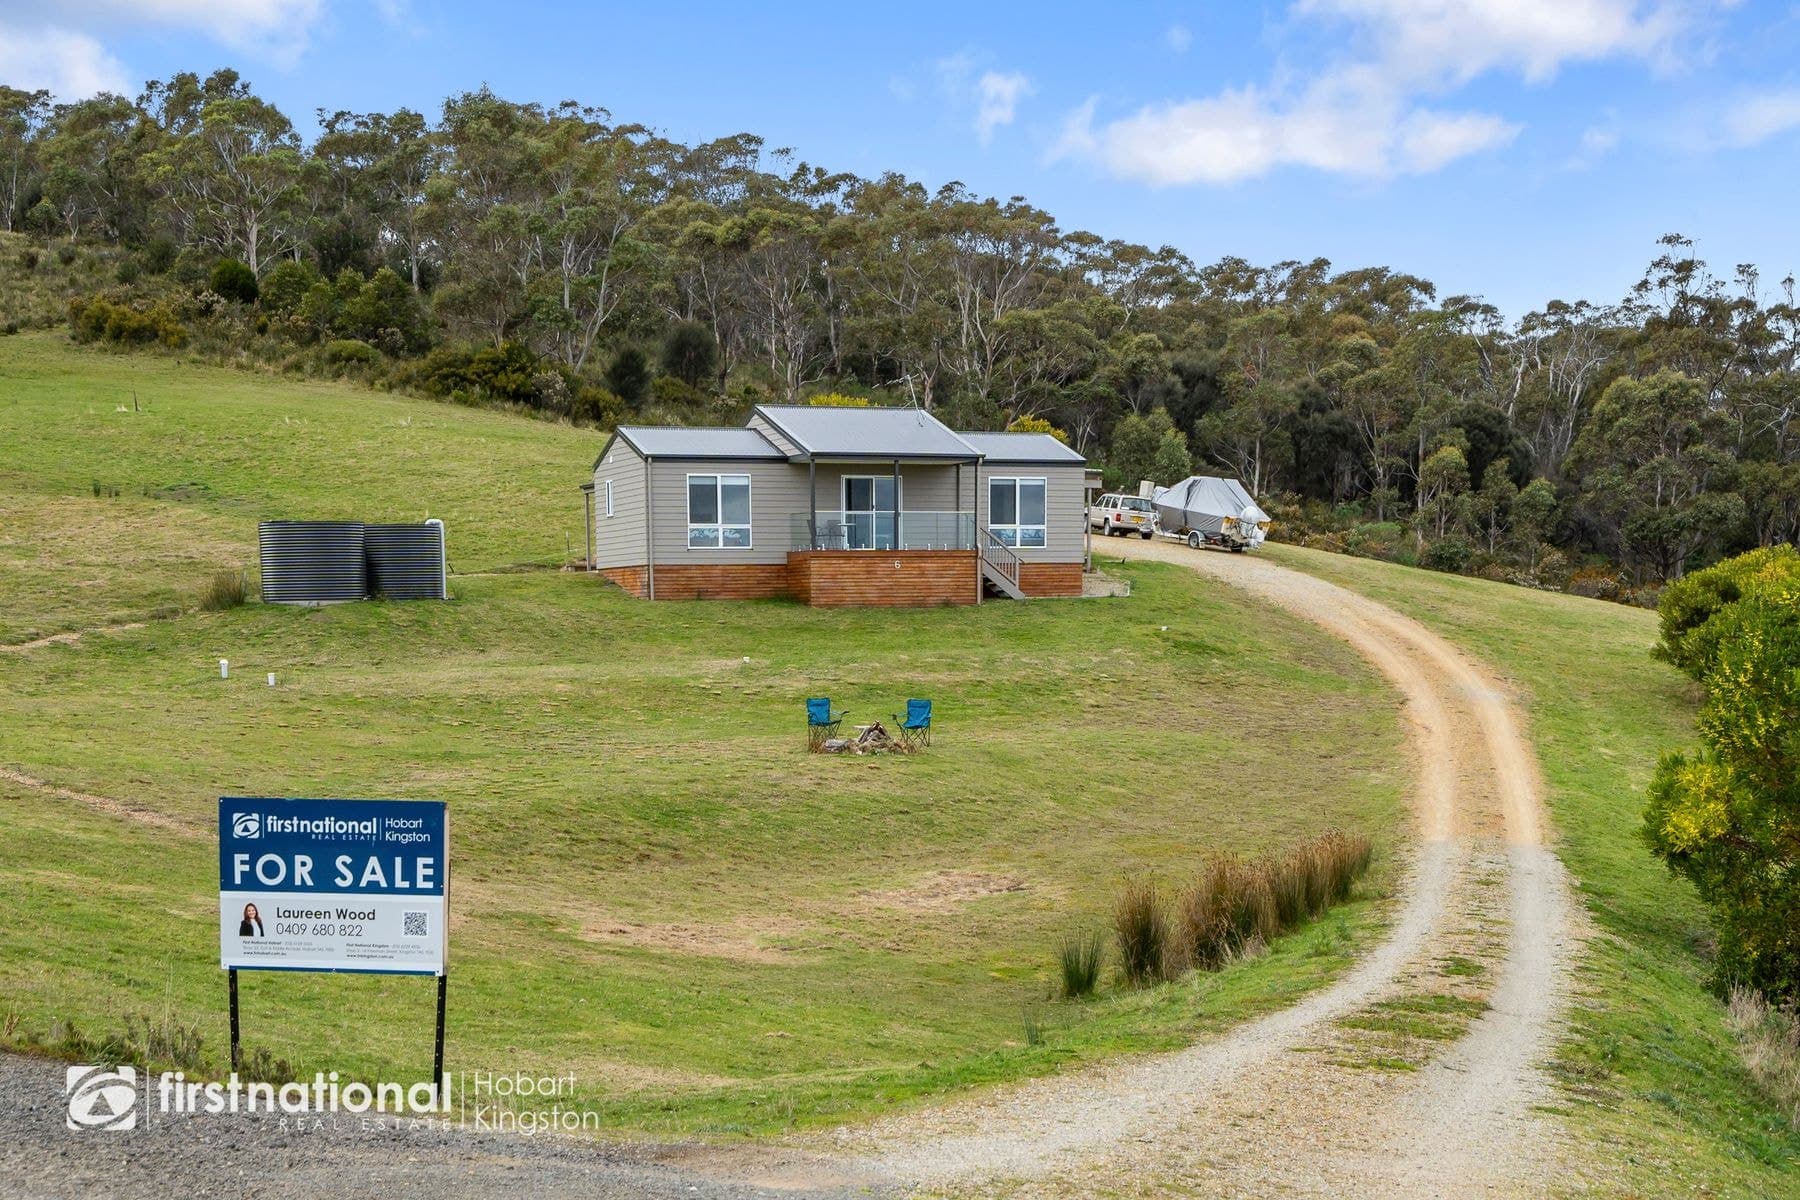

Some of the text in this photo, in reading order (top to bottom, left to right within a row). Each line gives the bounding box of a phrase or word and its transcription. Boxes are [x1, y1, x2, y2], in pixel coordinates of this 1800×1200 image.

[894, 560, 901, 569] 6
[266, 816, 377, 834] firstnational
[385, 817, 423, 829] Hobart
[385, 832, 431, 844] Kingston
[233, 853, 434, 889] FOR SALE
[276, 907, 376, 921] Laureen Wood
[276, 922, 363, 938] 0409 680 822
